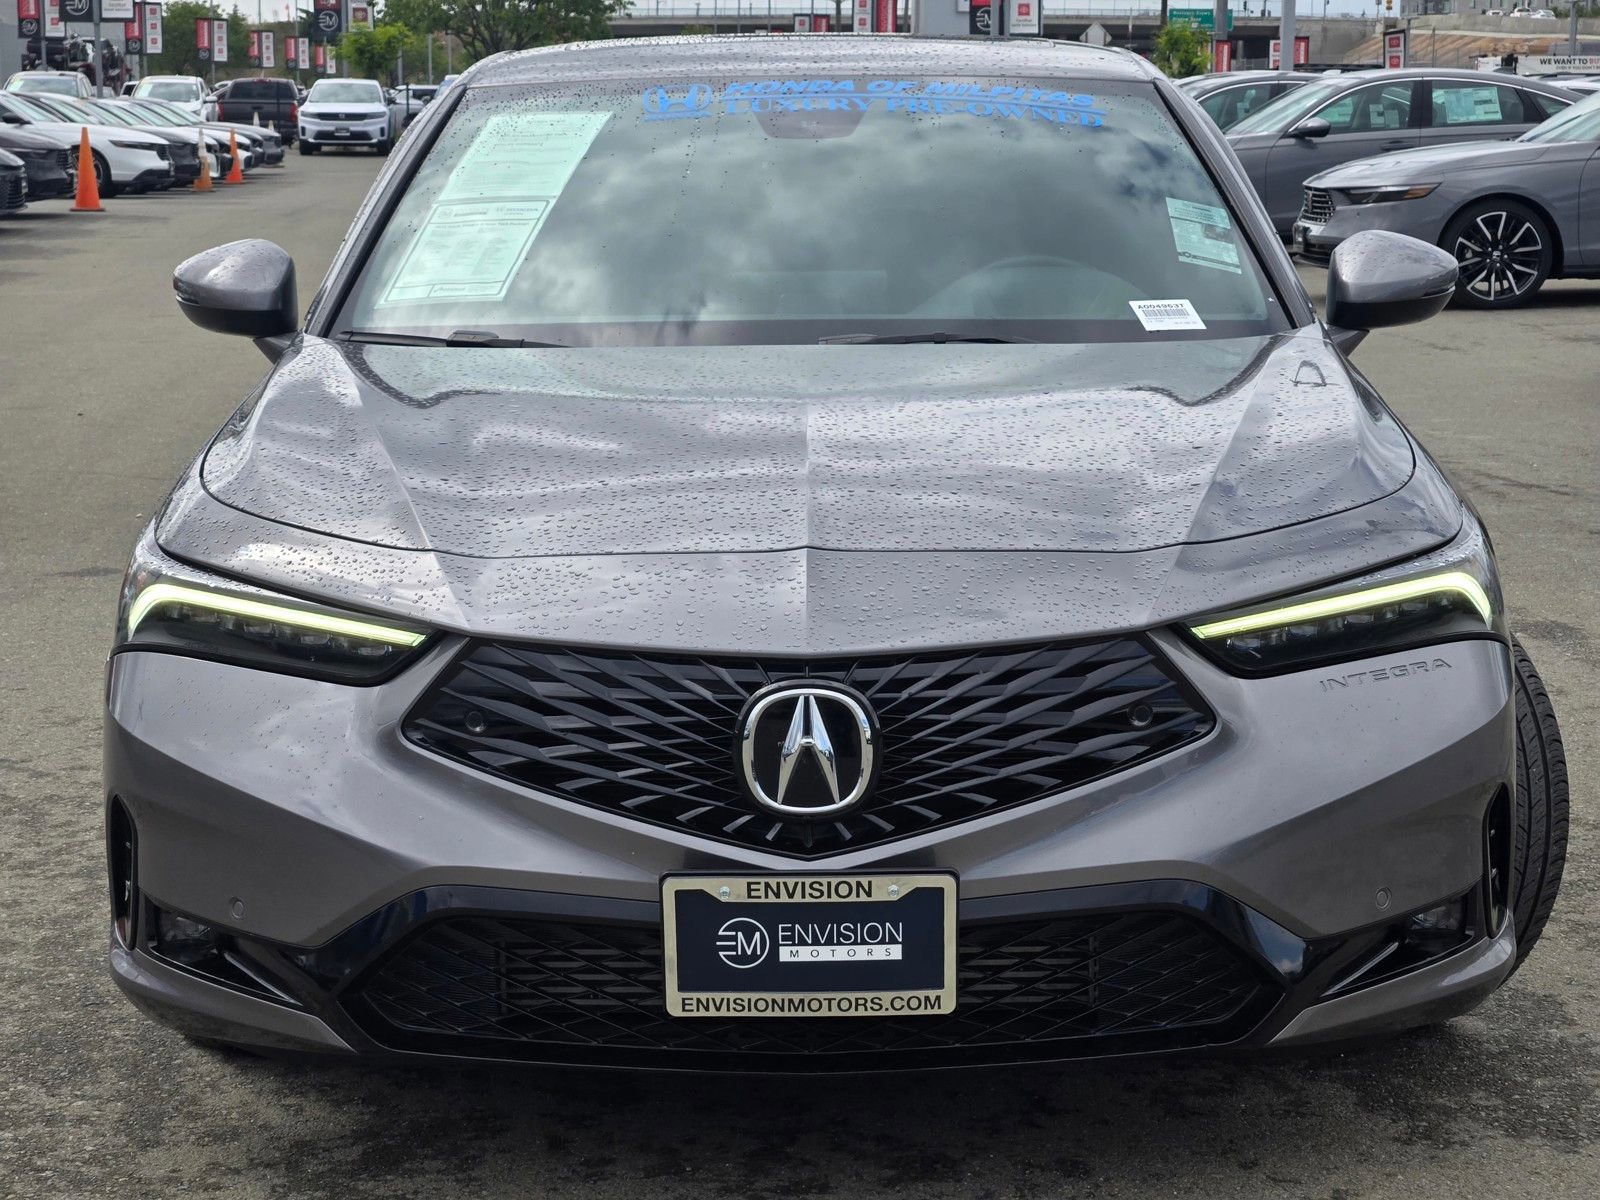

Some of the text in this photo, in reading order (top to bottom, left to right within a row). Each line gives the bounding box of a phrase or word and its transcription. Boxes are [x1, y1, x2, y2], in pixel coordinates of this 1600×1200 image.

[725, 79, 1095, 108] HONDA OF MILPITAS
[726, 97, 1103, 127] LUXURY PRE-OWNED
[1319, 658, 1452, 692] INTEGRA
[746, 880, 873, 900] ENVISION
[778, 922, 903, 944] ENVISION
[789, 948, 892, 959] MOTORS
[681, 995, 942, 1013] ENVISIONMOTORS.COM
